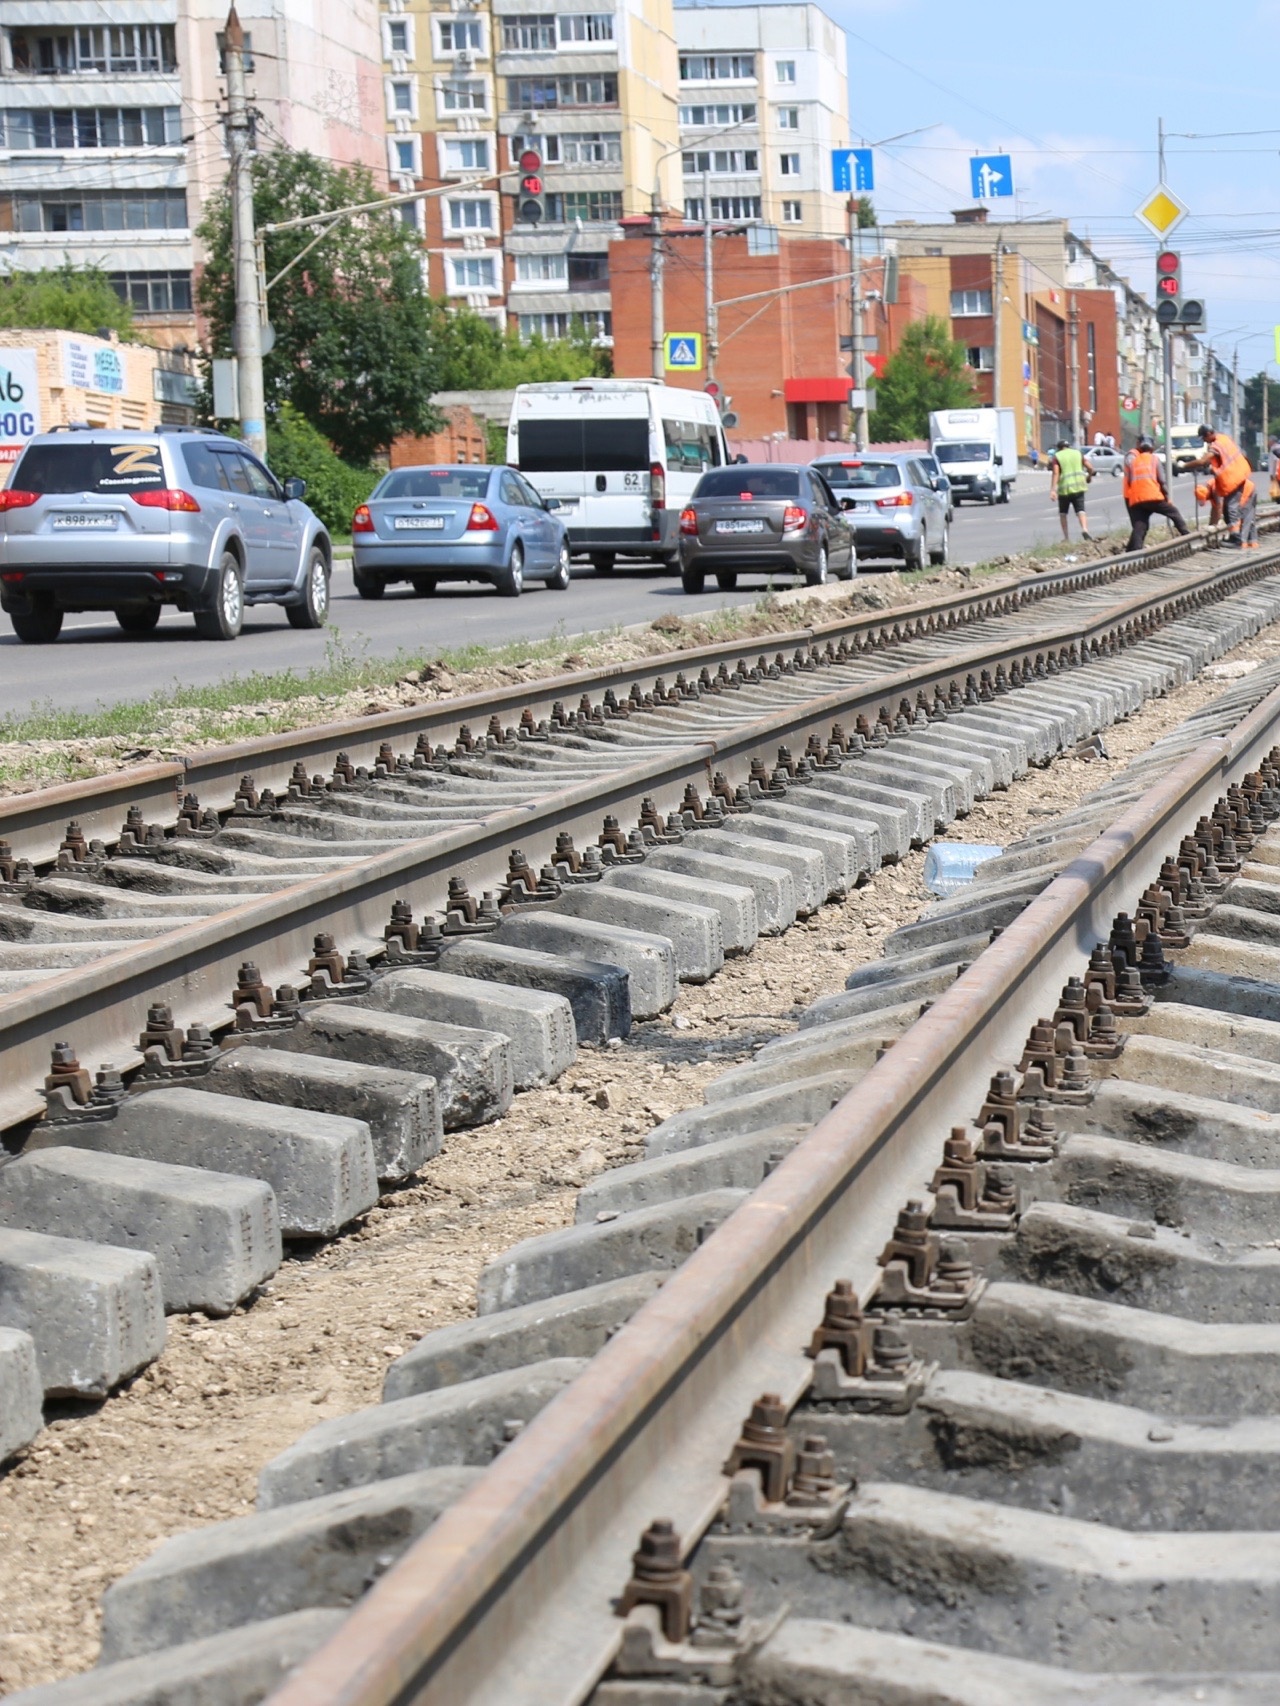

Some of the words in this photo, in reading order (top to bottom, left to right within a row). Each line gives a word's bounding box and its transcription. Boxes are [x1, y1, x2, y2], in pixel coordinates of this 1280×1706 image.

[1161, 279, 1178, 295] 40
[110, 445, 162, 474] Z
[624, 473, 639, 486] 62
